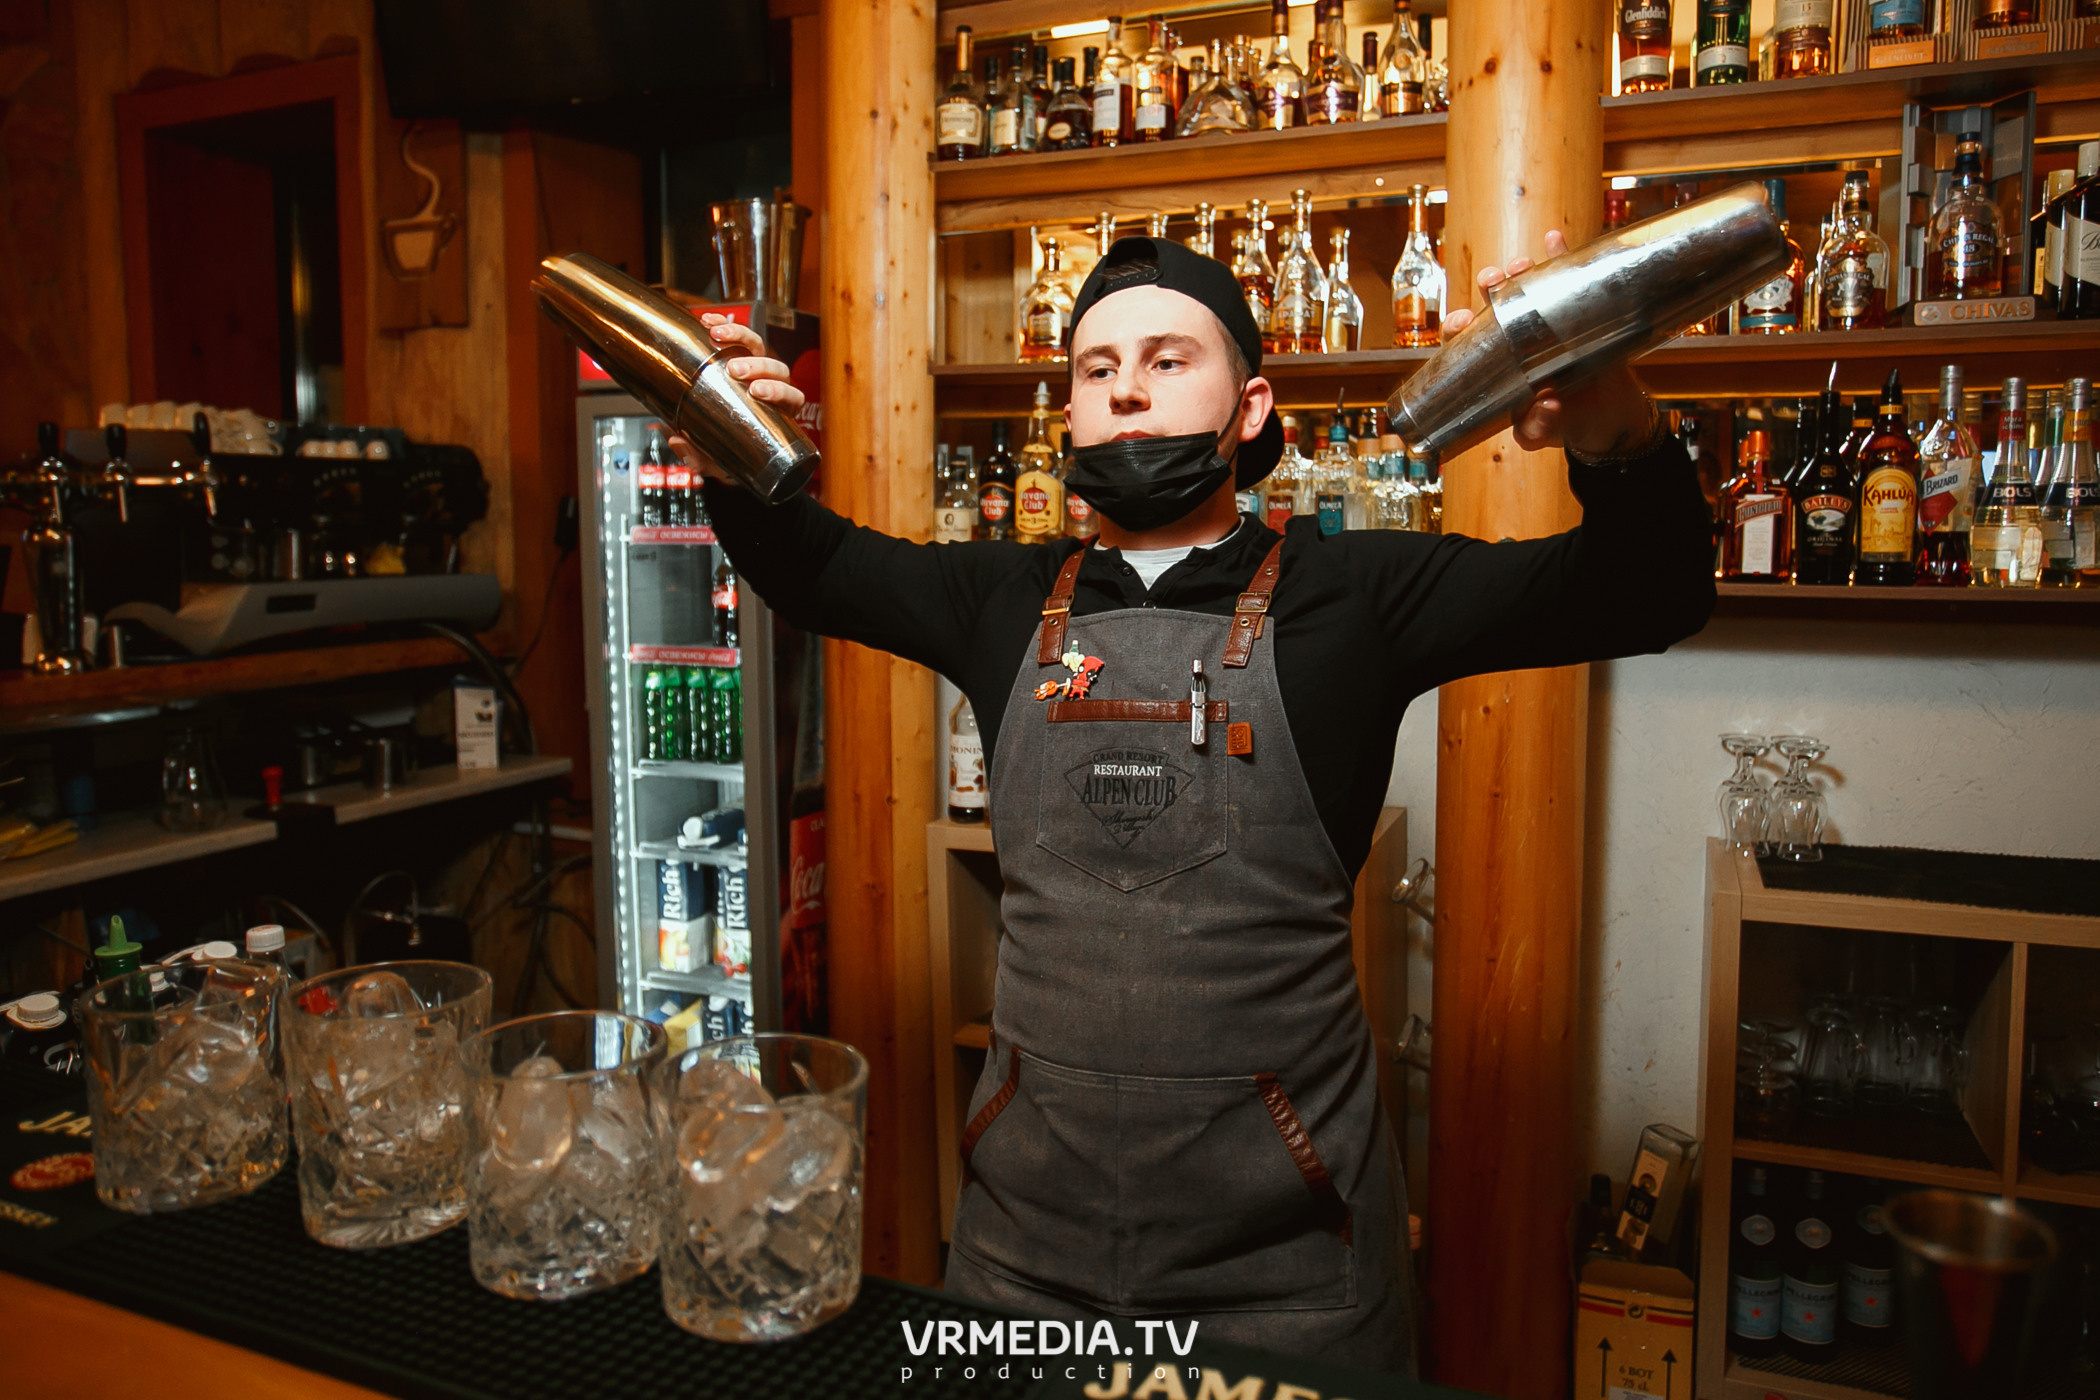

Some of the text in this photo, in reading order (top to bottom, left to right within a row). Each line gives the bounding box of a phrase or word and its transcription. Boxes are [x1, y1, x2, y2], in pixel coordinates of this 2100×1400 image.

[1625, 6, 1667, 23] Glenfiddich
[1965, 243, 1975, 252] 18
[1950, 300, 2031, 320] CHIVAS
[1926, 474, 1958, 495] BRIZARD
[1863, 485, 1914, 507] KAHLÚA
[1993, 487, 2032, 498] BOLS
[1024, 500, 1044, 510] Club
[1319, 501, 1342, 510] OLMECA
[1804, 497, 1848, 510] BAILEYS
[984, 507, 1002, 516] Club
[1093, 751, 1164, 764] GRAND RESORT
[1094, 764, 1163, 777] RESTAURANT
[1081, 773, 1176, 806] ALPEN CLUB
